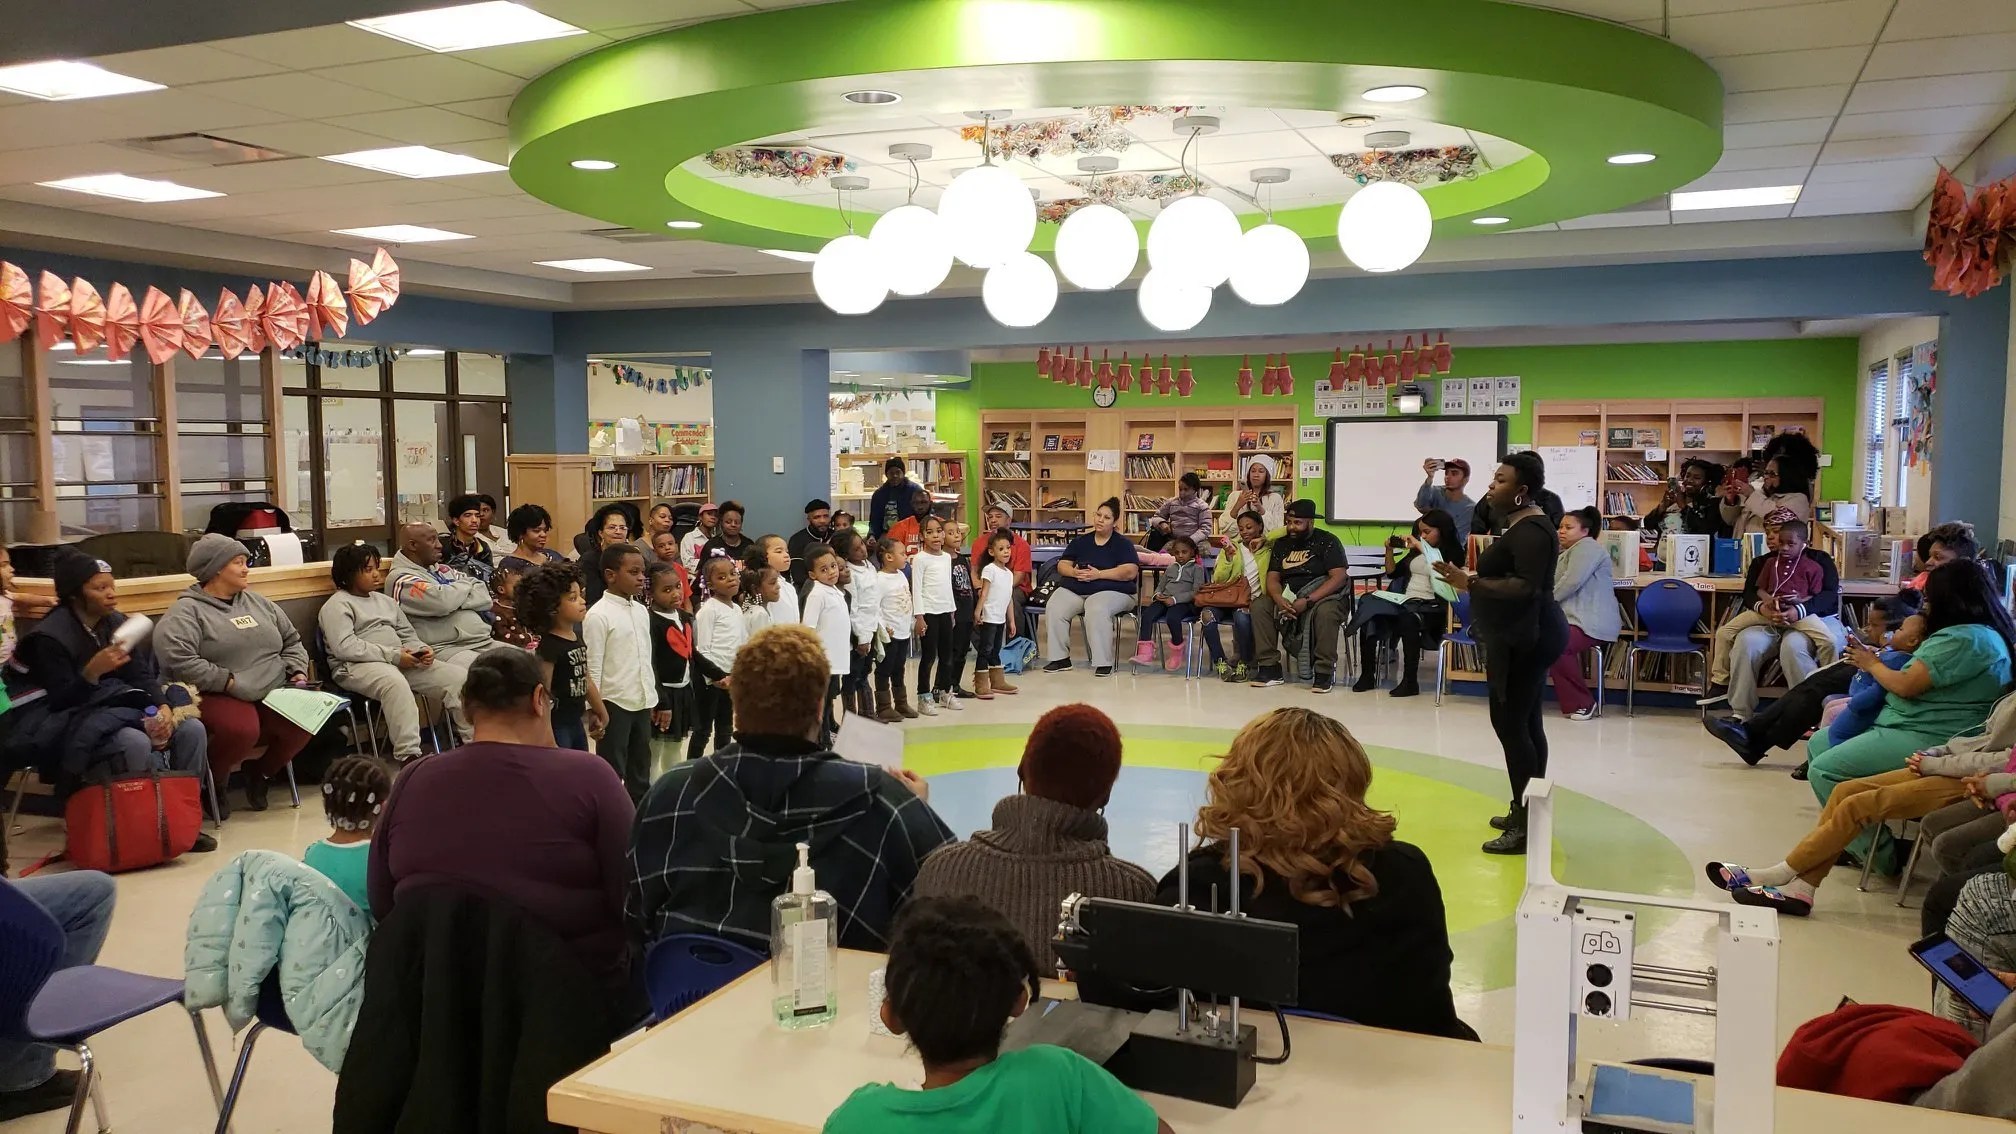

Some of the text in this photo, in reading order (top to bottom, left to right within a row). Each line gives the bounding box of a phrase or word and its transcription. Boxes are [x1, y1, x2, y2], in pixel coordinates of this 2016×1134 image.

[671, 428, 706, 437] Commended
[1286, 550, 1310, 561] NIKE
[1612, 579, 1633, 587] antasy
[1696, 582, 1714, 590] Tales
